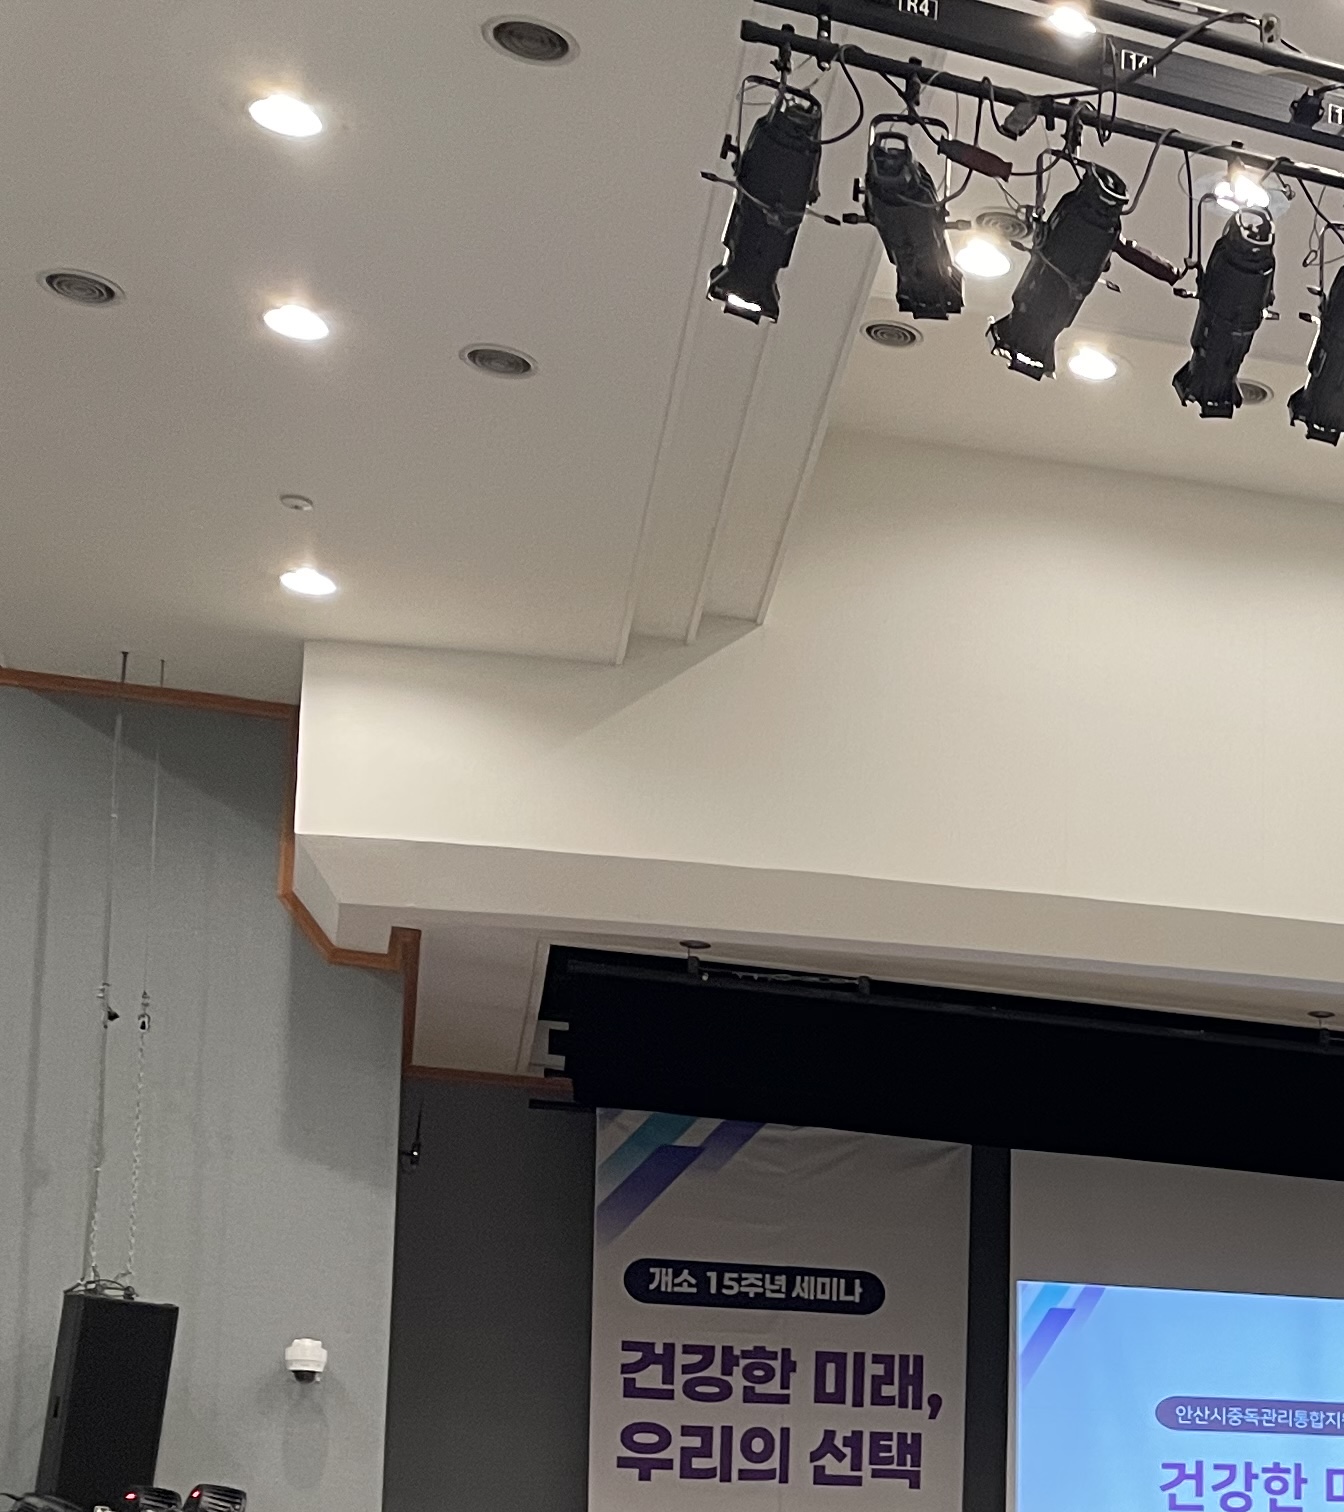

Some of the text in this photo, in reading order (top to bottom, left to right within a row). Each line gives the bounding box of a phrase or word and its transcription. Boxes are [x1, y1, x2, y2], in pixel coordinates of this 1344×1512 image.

[648, 1266, 863, 1303] 개소 15주년 세미나
[620, 1340, 943, 1420] 건강한 미래,
[616, 1420, 922, 1490] 우리의 선택
